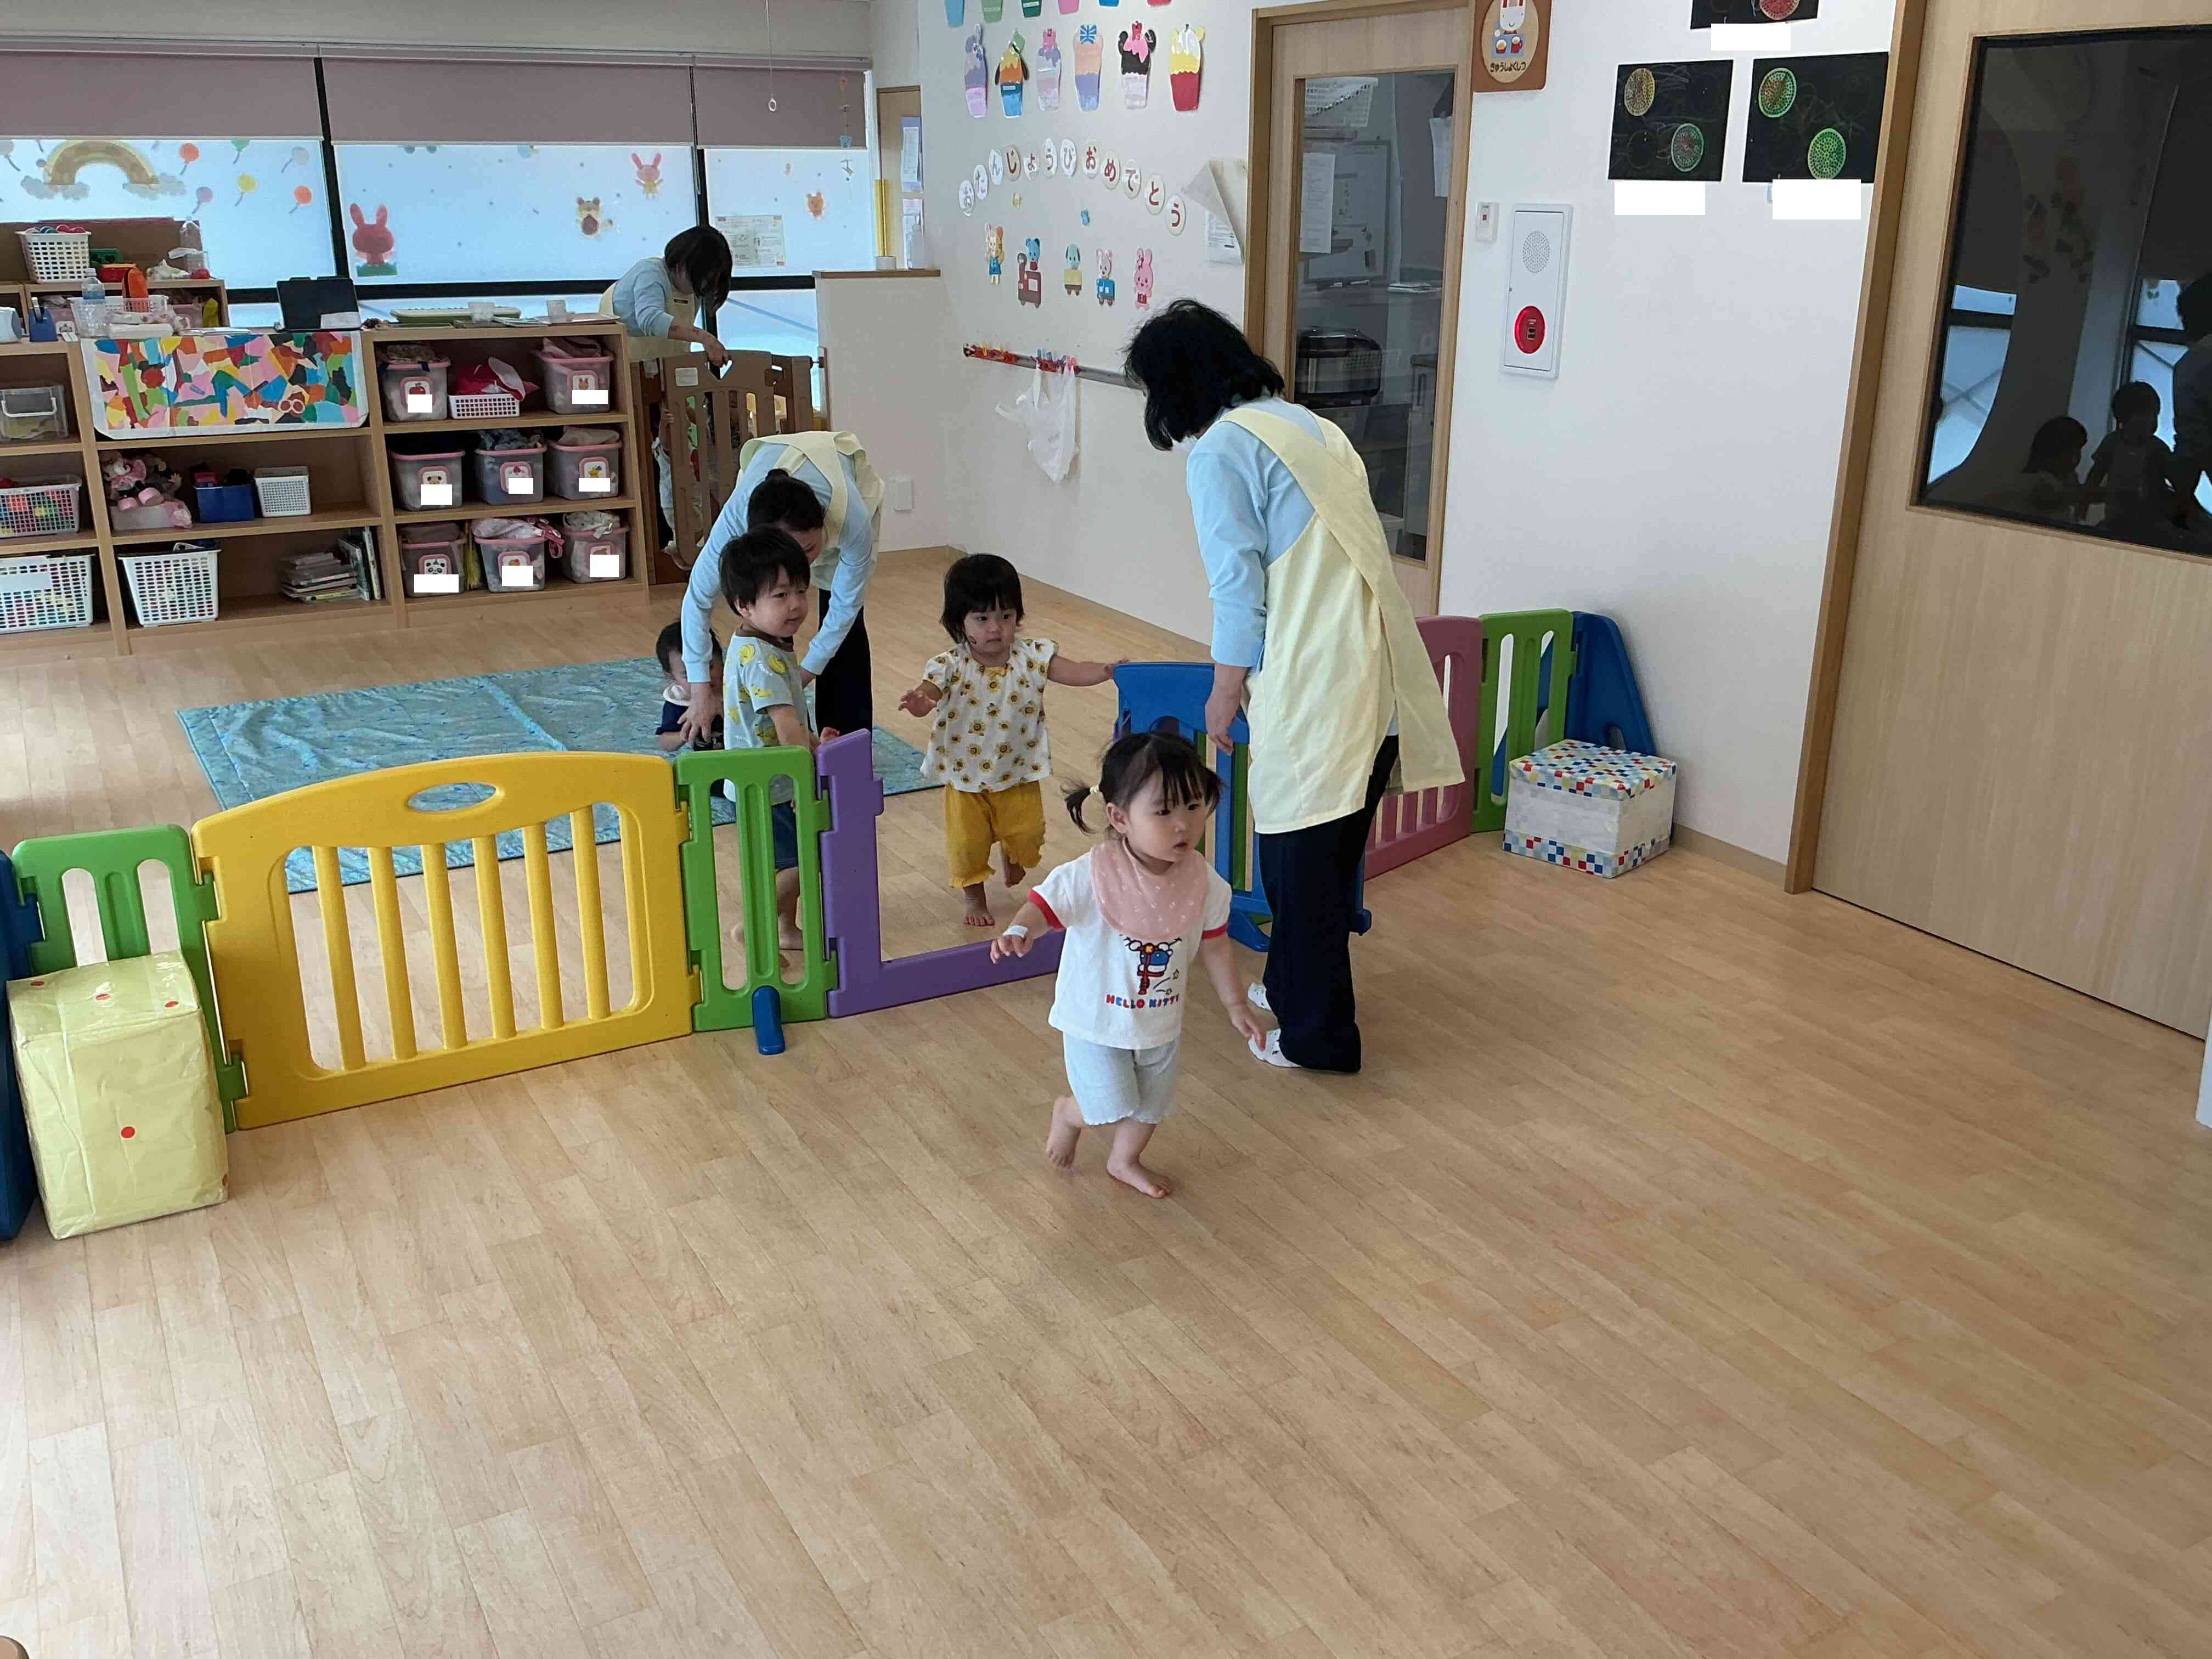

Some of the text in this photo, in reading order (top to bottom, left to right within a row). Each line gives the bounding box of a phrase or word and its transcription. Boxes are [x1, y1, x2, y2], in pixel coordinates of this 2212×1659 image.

[1490, 61, 1526, 72] きゅうしょくしつ
[1106, 992, 1179, 1009] HELLO KITTY
